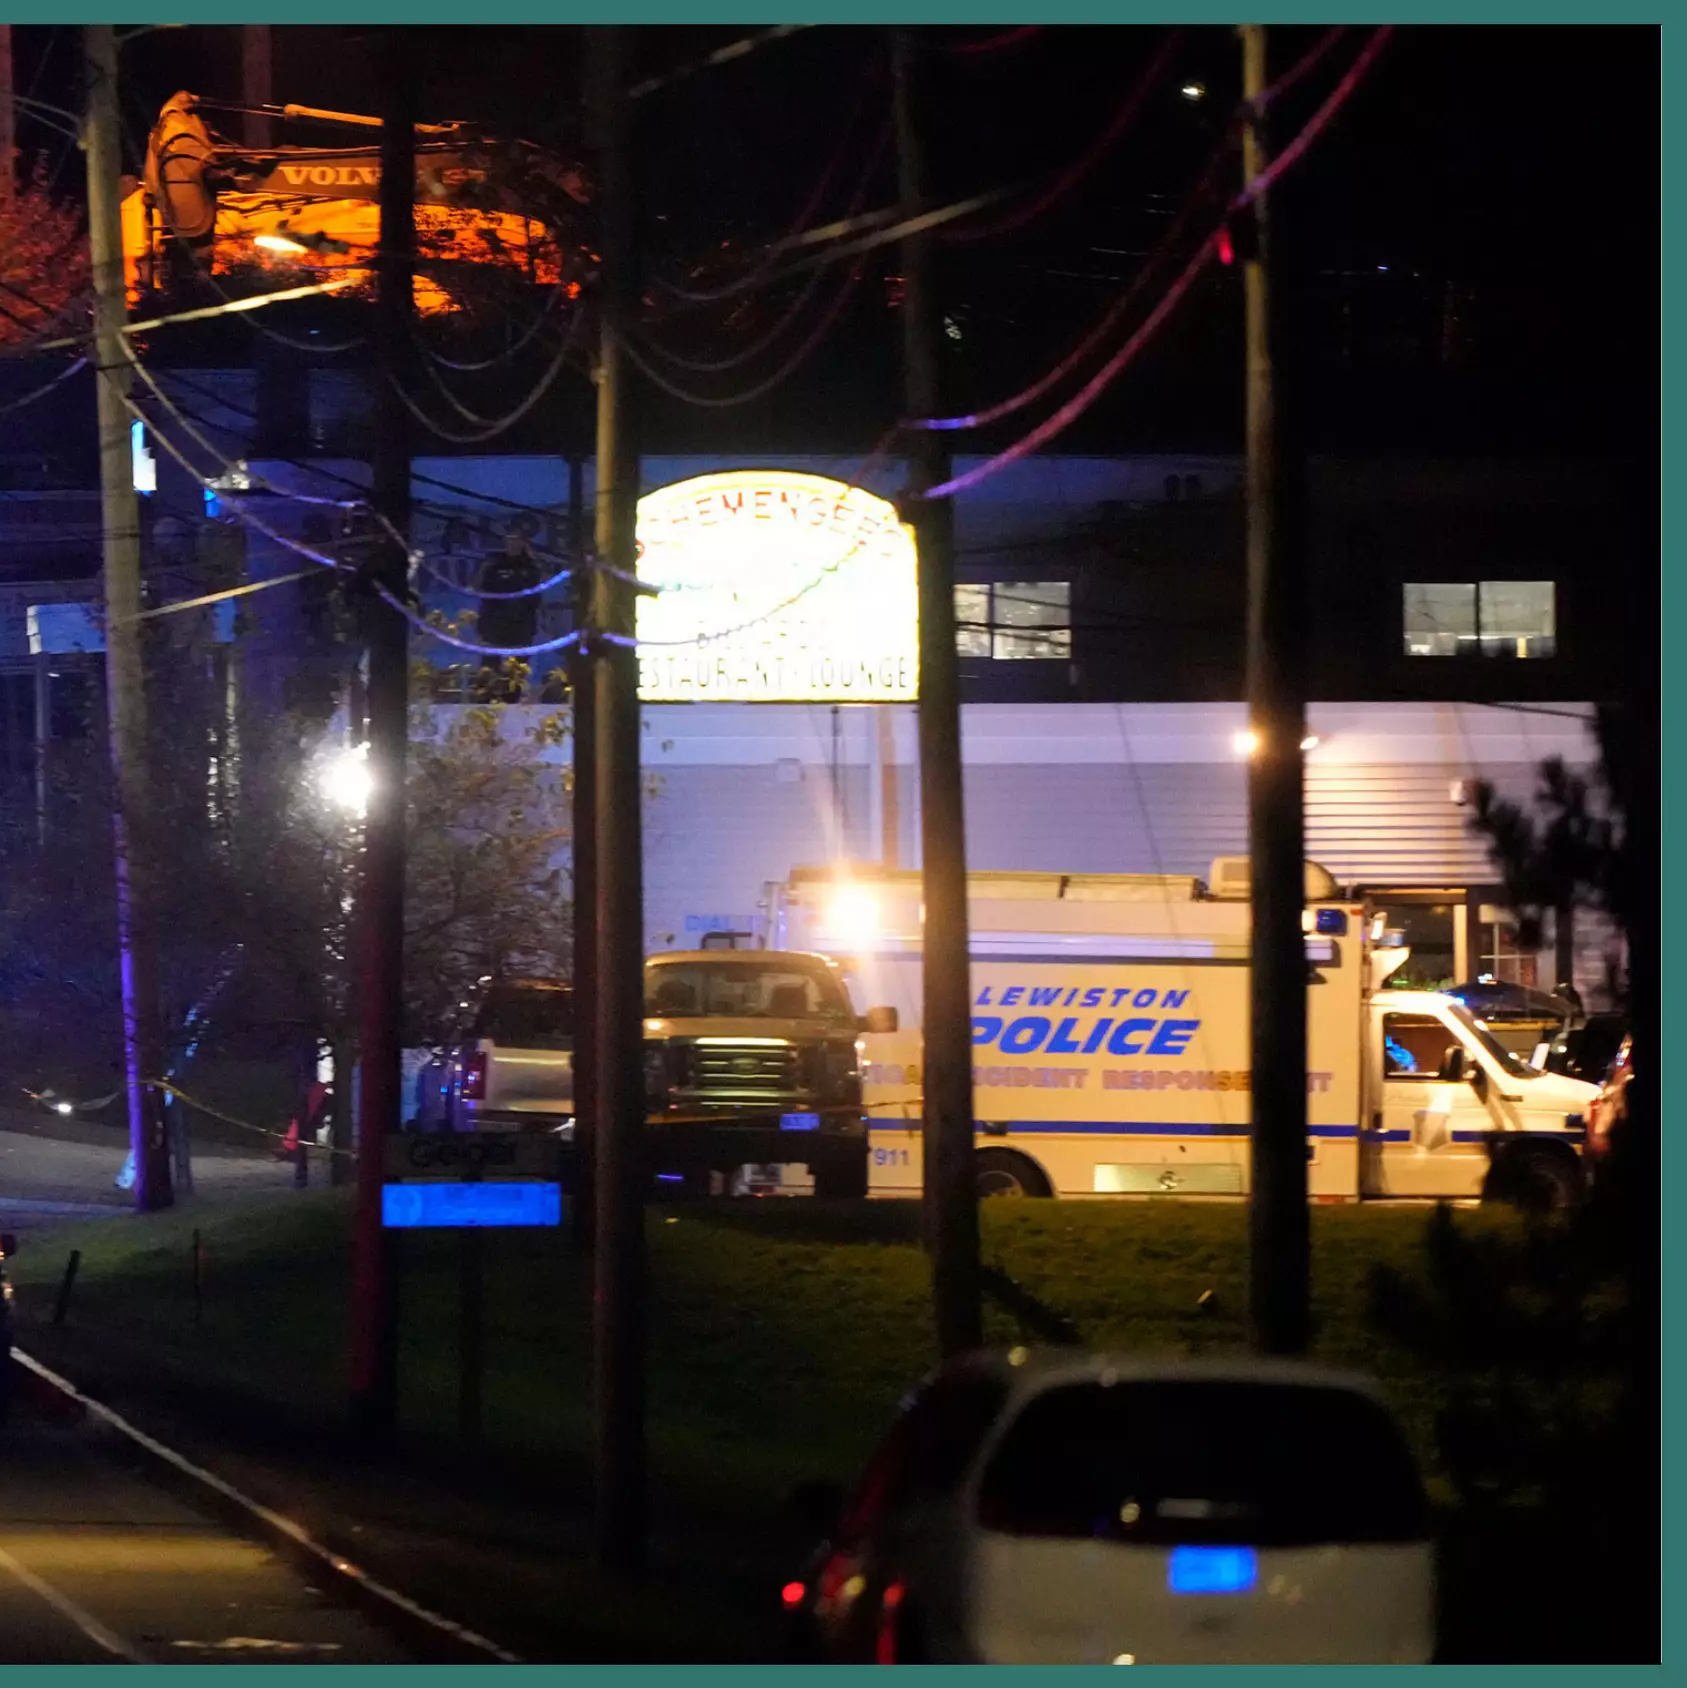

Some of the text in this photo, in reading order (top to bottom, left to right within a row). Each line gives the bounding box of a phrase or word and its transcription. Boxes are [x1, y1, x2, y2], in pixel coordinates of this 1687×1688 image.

[278, 164, 383, 186] VOLV
[810, 655, 909, 689] LOUNGE
[975, 986, 1191, 1008] LEWISTON
[971, 1016, 1201, 1055] POLICE
[874, 1147, 910, 1166] 911
